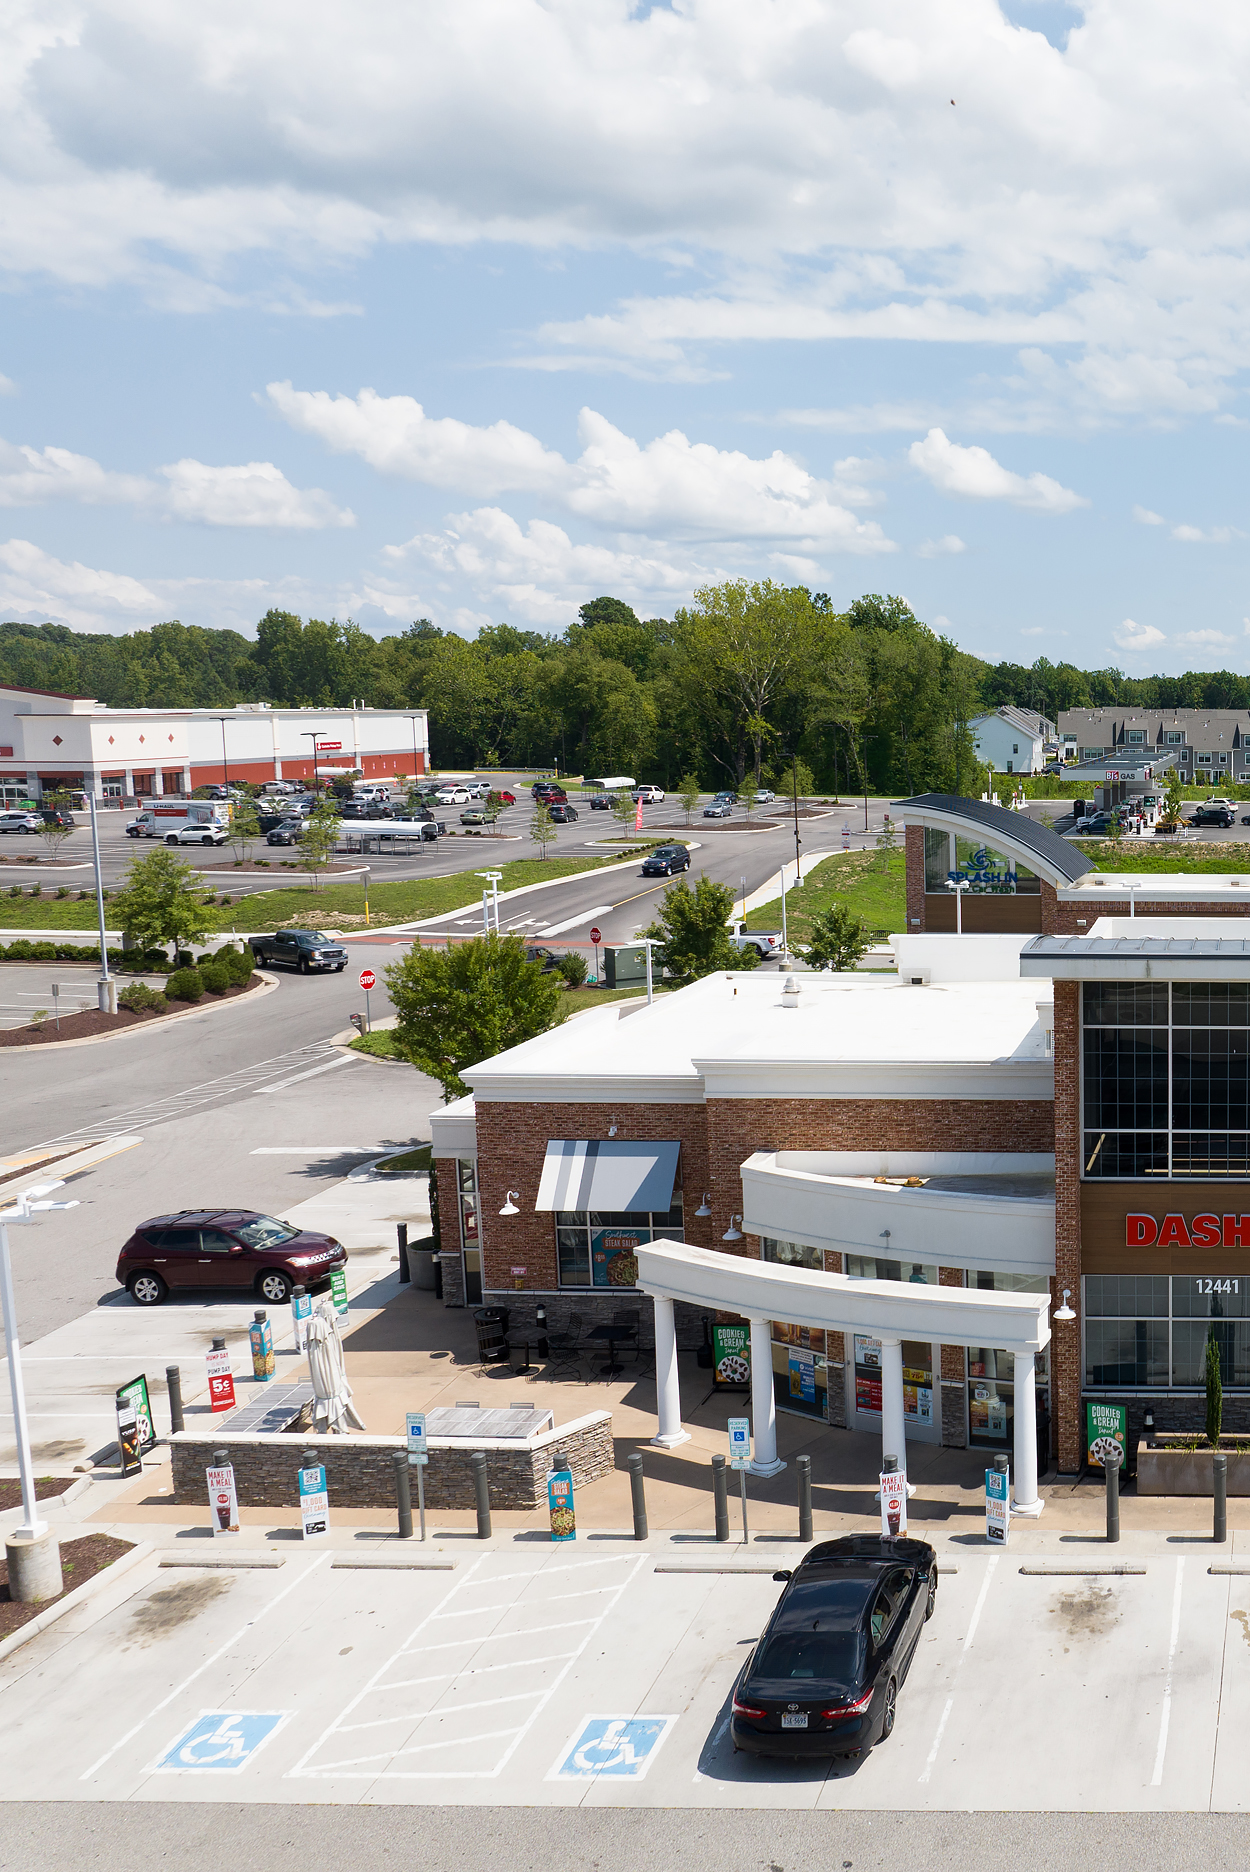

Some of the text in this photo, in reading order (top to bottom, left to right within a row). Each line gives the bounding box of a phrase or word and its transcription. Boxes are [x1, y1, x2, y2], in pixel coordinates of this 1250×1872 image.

[948, 872, 1018, 883] SPLASH IN
[361, 975, 375, 984] STOP
[1196, 1279, 1239, 1293] 12441
[718, 1329, 745, 1340] COOKIES
[724, 1338, 744, 1348] CREAM
[1092, 1406, 1120, 1418] COOKIES
[1098, 1417, 1119, 1429] CREAM
[208, 1471, 224, 1480] MAKE
[882, 1476, 897, 1485] MAKE
[216, 1478, 232, 1487] MEAL
[889, 1484, 903, 1492] MEAL
[303, 1496, 322, 1507] $1,000
[995, 1510, 1005, 1518] CARD
